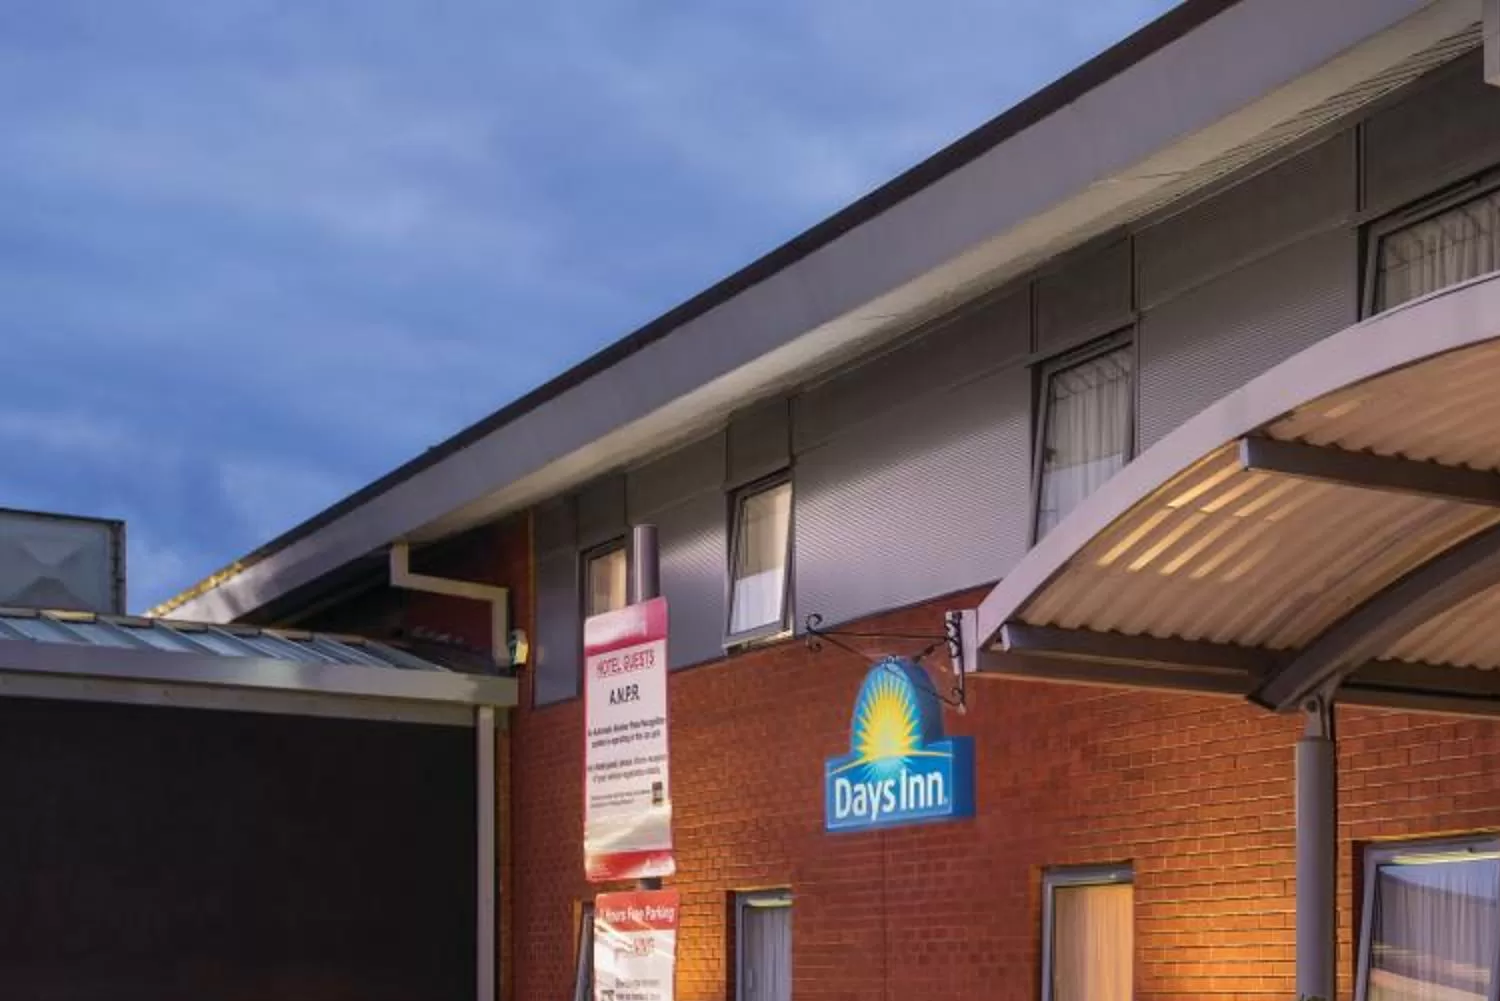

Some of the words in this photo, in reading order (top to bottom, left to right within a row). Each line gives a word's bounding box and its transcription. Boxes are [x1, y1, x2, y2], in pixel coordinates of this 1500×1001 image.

[835, 777, 896, 821] Days
[900, 766, 943, 810] Inn
[645, 904, 675, 923] Parking
